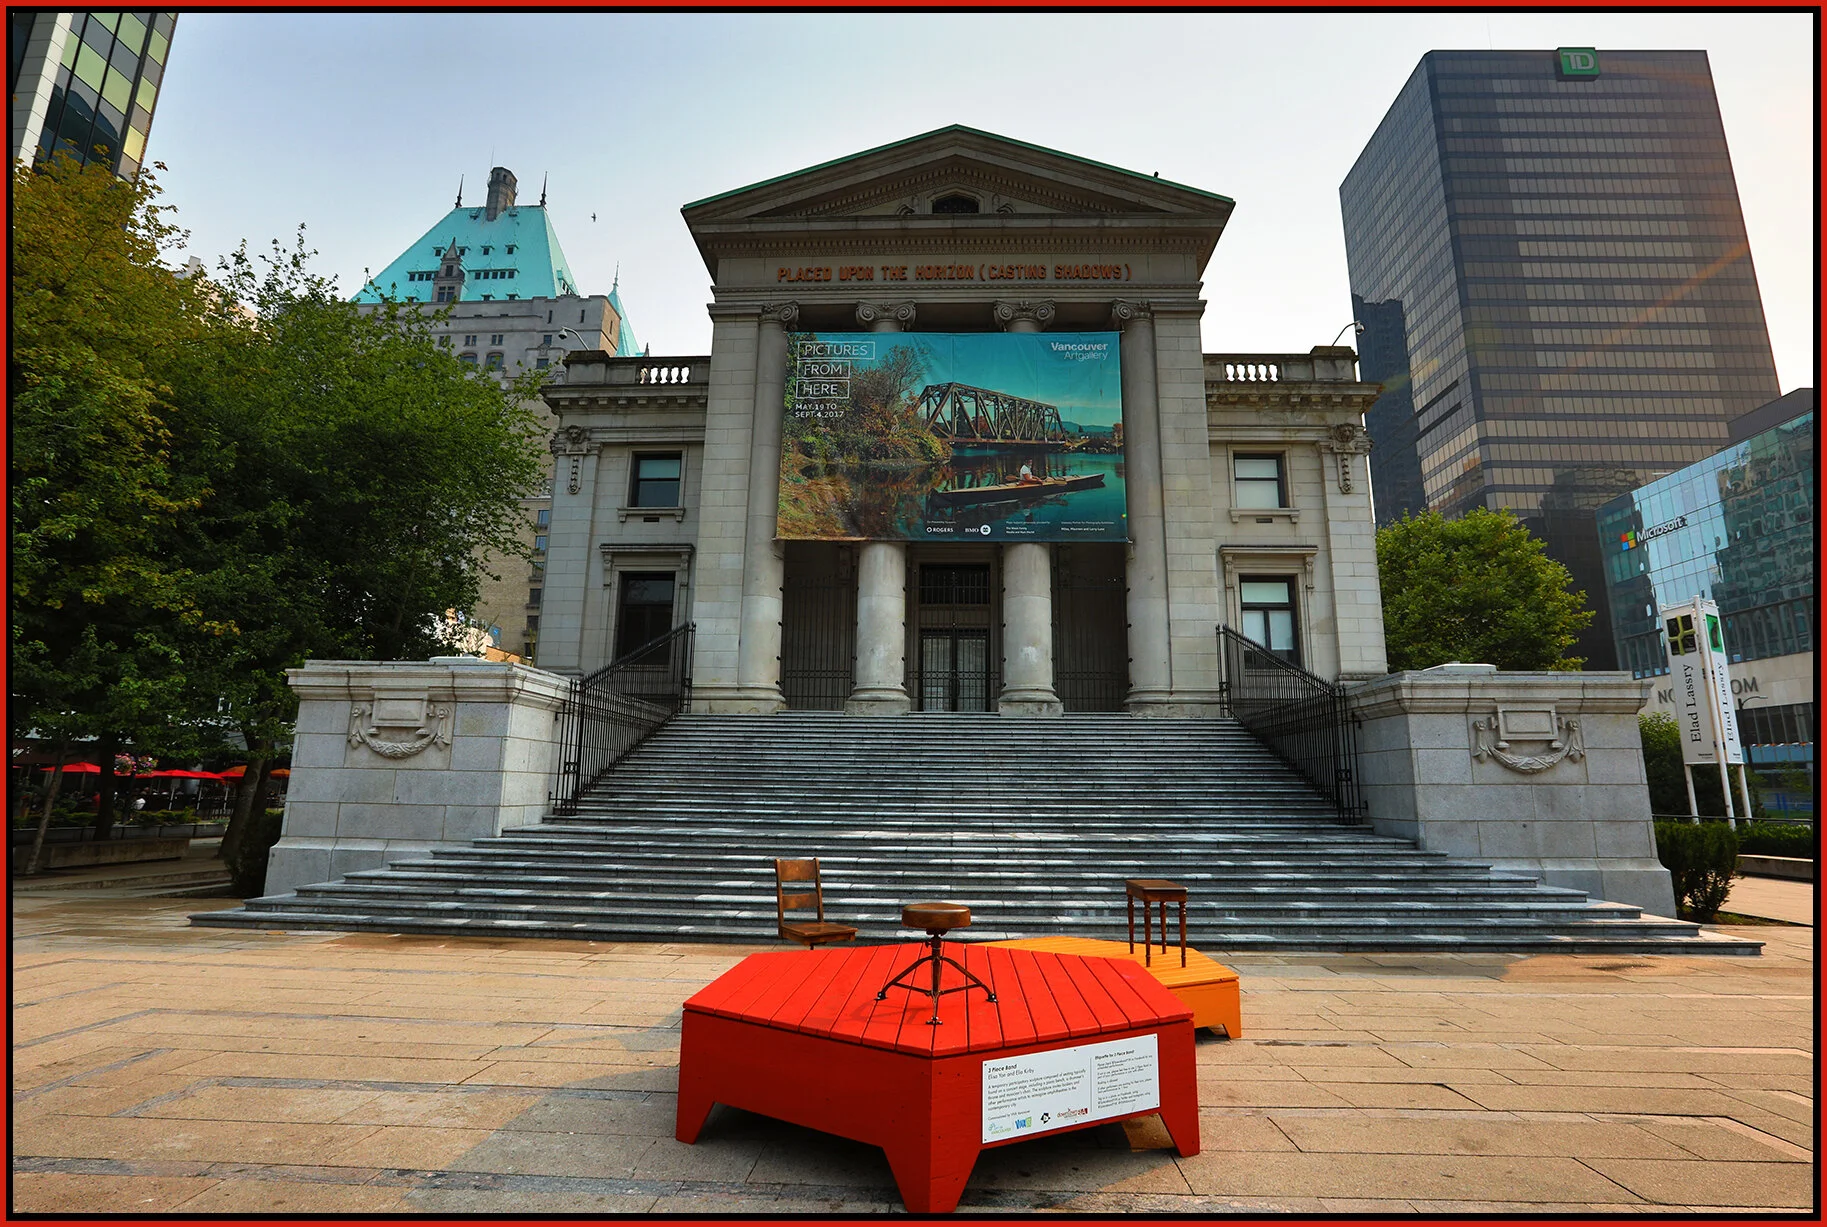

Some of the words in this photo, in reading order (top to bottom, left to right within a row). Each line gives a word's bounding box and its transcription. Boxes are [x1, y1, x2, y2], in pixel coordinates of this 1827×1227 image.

[1562, 52, 1594, 70] TD
[777, 267, 832, 282] PLACED
[839, 266, 874, 281] UPON
[881, 265, 908, 281] THE
[915, 264, 974, 280] HORIZON
[804, 344, 868, 356] PICTURES
[1050, 342, 1108, 351] Vancouver
[804, 364, 842, 376] FROM
[802, 384, 838, 395] HERE
[1636, 516, 1688, 542] Microsoft
[1683, 664, 1697, 708] Lassry
[1688, 712, 1702, 743] Elad
